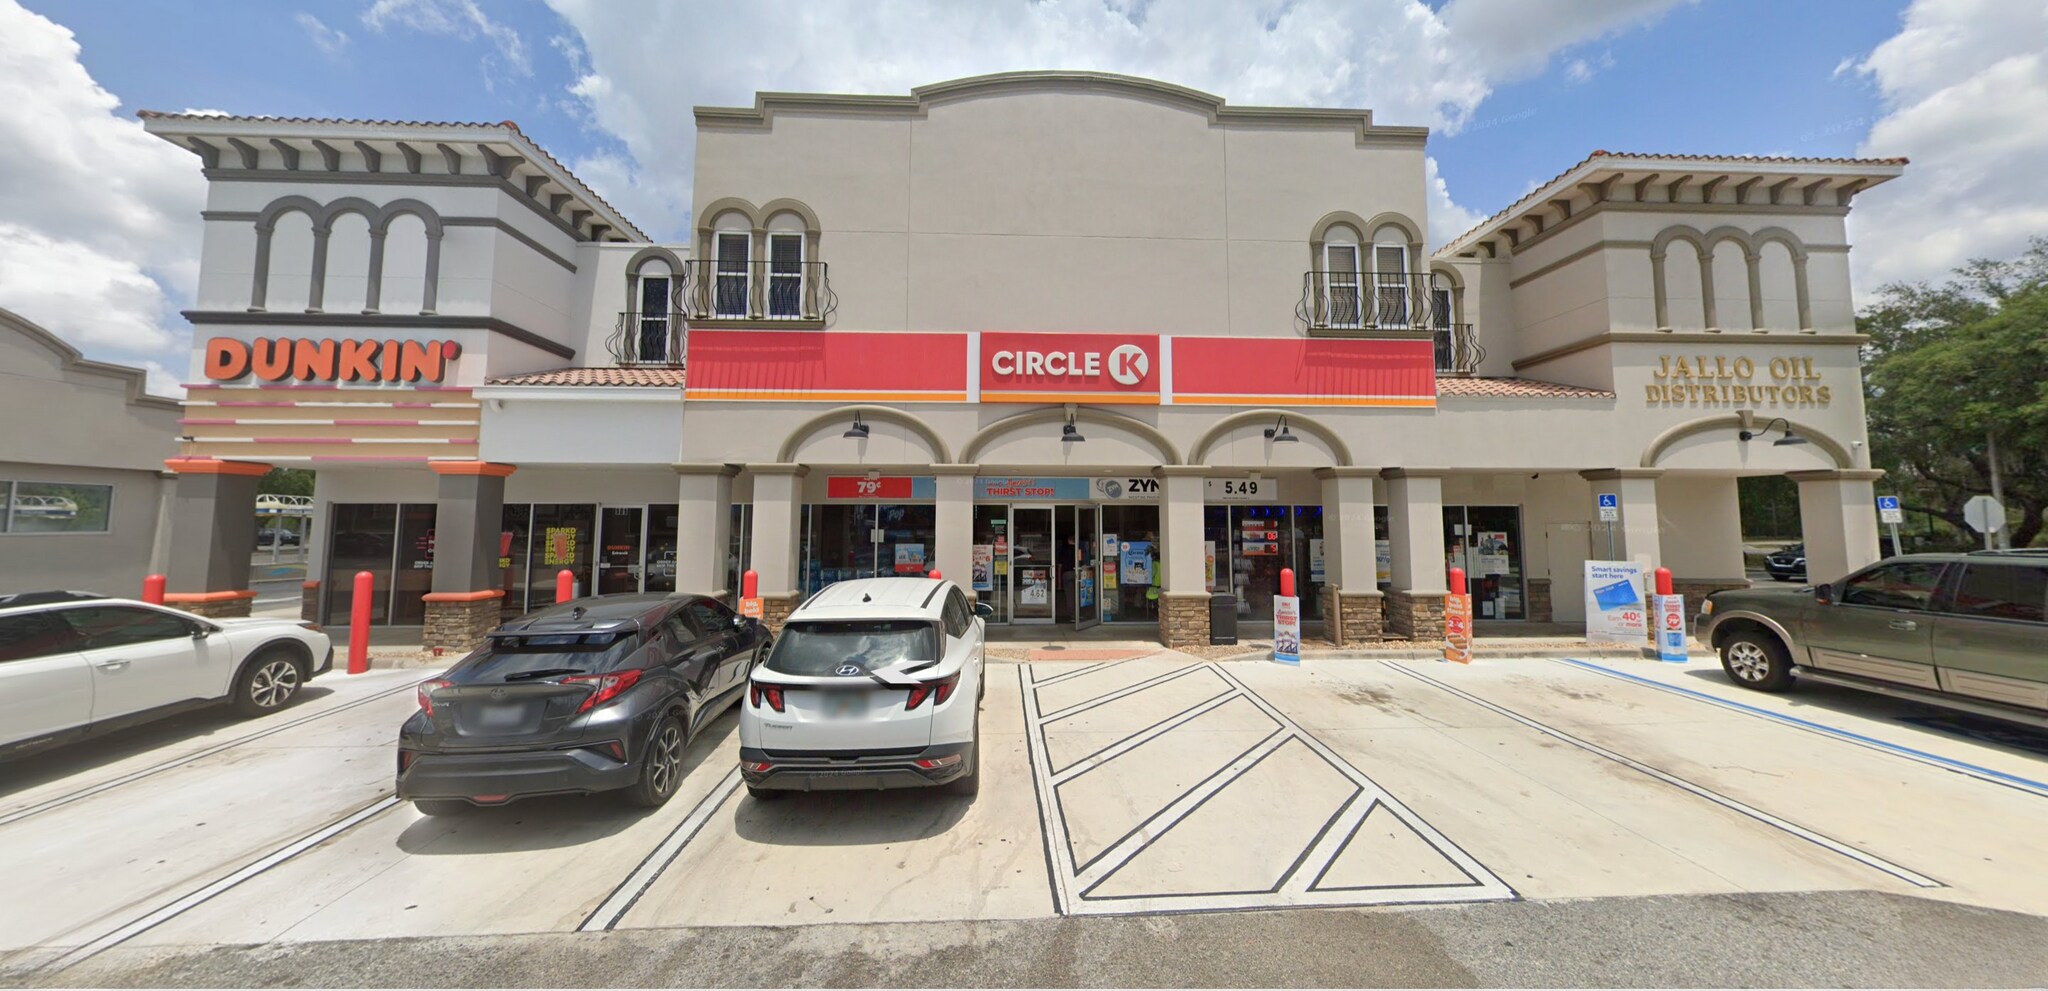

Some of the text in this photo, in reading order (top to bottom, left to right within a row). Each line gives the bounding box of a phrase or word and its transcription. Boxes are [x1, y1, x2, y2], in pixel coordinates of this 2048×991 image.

[205, 336, 460, 382] DUNKIN'
[992, 347, 1147, 384] CIRCLE K
[1653, 355, 1821, 380] JALLO OIL
[1645, 384, 1831, 405] DISTRIBUTORS
[987, 488, 1054, 496] THIRST STOP!
[1129, 479, 1160, 492] ZYN
[1225, 481, 1258, 494] 5.49
